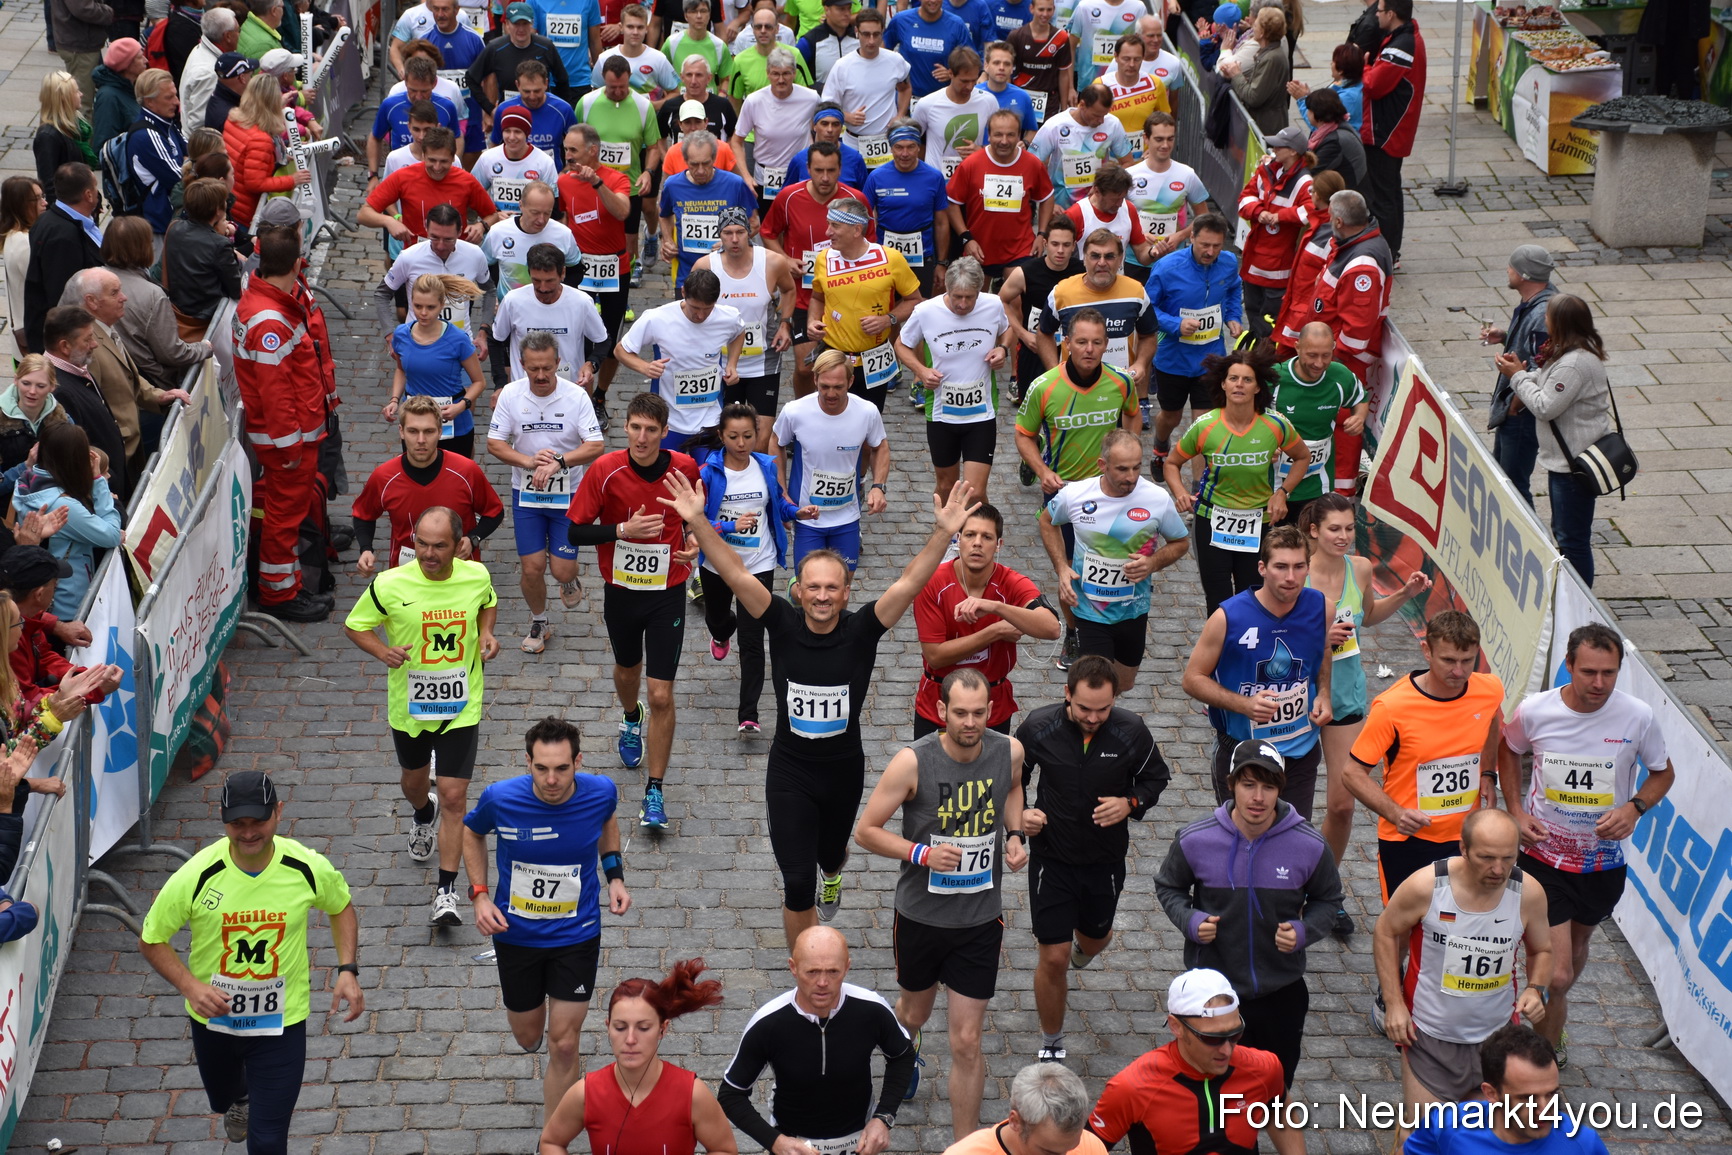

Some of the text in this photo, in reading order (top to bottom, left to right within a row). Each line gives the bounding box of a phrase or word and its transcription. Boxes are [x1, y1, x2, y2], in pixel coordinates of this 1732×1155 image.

[550, 22, 578, 35] 2276
[300, 19, 308, 61] Laufsport
[1101, 42, 1115, 55] 12
[1110, 93, 1157, 112] MAX BÖGL
[290, 127, 302, 152] BMW
[866, 142, 888, 156] 350
[600, 150, 624, 163] 257
[1075, 161, 1092, 175] 55
[498, 187, 522, 201] 259
[996, 184, 1012, 198] 24
[686, 224, 720, 239] 2512
[1149, 222, 1166, 235] 28
[887, 240, 918, 254] 2641
[583, 264, 616, 278] 2168
[827, 268, 891, 288] MAX BÖGL
[692, 370, 712, 380] Neumarkt
[680, 375, 716, 395] 2397
[946, 390, 982, 407] 3043
[1054, 408, 1118, 430] BOCK
[1212, 450, 1270, 467] BOCK
[526, 474, 564, 492] 271
[812, 472, 830, 480] PARTL
[814, 479, 854, 496] 2557
[536, 495, 554, 504] Harry
[1214, 508, 1230, 516] PARTL
[1216, 516, 1256, 535] 2791
[1222, 535, 1246, 546] Andrea
[616, 544, 634, 552] PARTL
[624, 554, 658, 574] 289
[1086, 556, 1102, 566] PARTL
[626, 575, 652, 584] Markus
[1096, 588, 1120, 596] Hubert
[422, 609, 466, 622] Müller
[432, 633, 456, 651] M
[1238, 626, 1260, 650] 4
[414, 680, 464, 700] 2390
[790, 687, 808, 696] PARTL
[1272, 692, 1299, 702] Neumarkt
[420, 704, 457, 713] Wolfgang
[792, 696, 842, 718] 3111
[1270, 725, 1296, 736] Martin
[1418, 760, 1471, 772] PARTL Neumarkt
[1544, 758, 1602, 768] PARTL Neumarkt
[1432, 768, 1470, 794] 236
[1564, 770, 1594, 790] 44
[938, 778, 994, 812] RUN
[1440, 796, 1462, 808] Josef
[1559, 793, 1599, 804] Matthias
[938, 808, 996, 838] THIS
[514, 864, 570, 878] PARTL Neumarkt
[940, 876, 984, 886] Alexander
[532, 878, 560, 899] 87
[526, 902, 561, 912] Michael
[222, 909, 288, 925] Müller
[234, 938, 268, 964] M
[1448, 942, 1508, 955] PARTL Neumarkt
[1461, 954, 1504, 976] 161
[212, 980, 273, 992] PARTL Neumarkt
[1458, 979, 1500, 990] Hermann
[223, 992, 278, 1014] 818
[232, 1019, 256, 1028] Mike
[824, 1138, 858, 1151] Neumarkt
